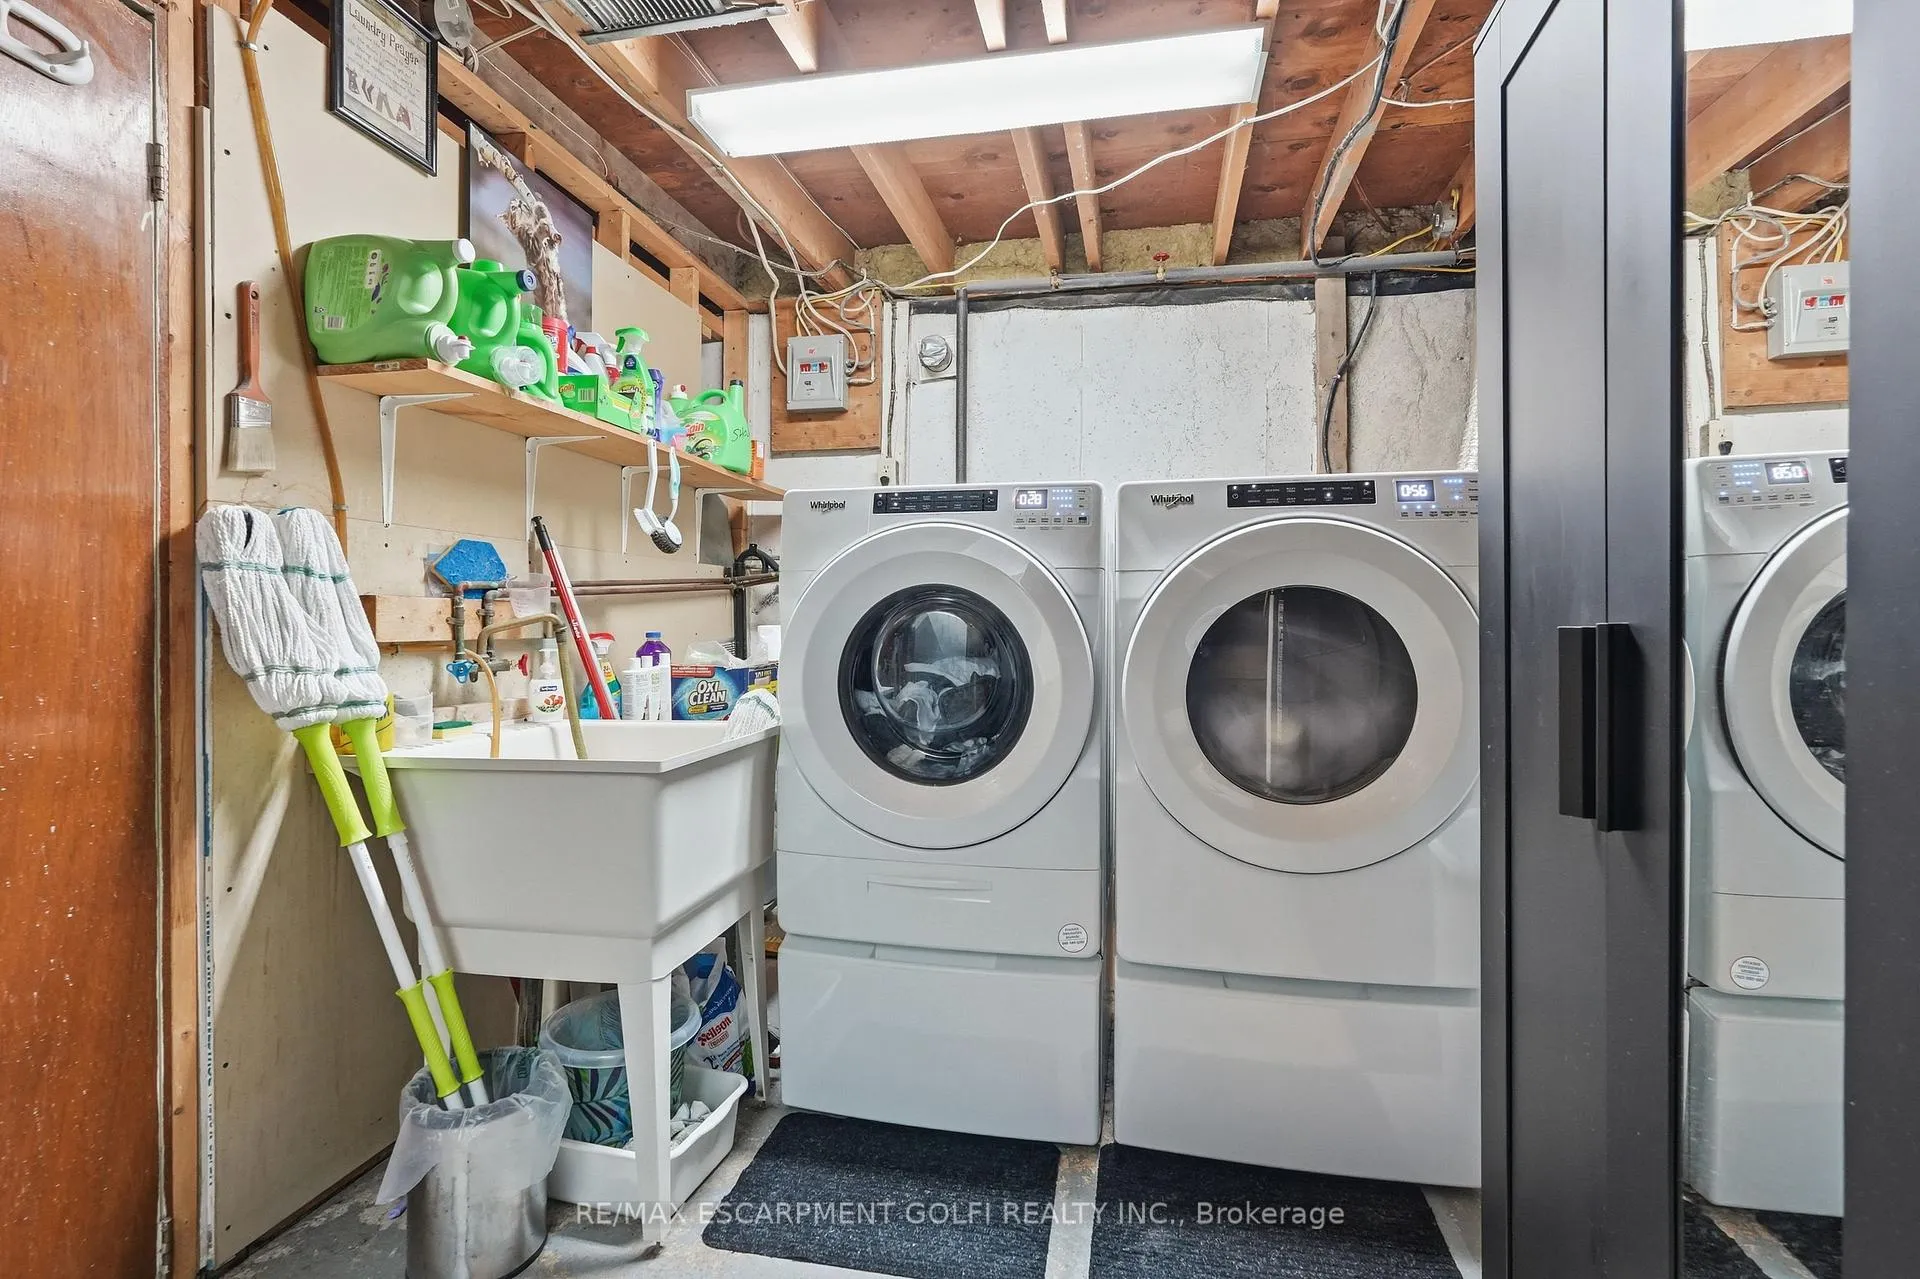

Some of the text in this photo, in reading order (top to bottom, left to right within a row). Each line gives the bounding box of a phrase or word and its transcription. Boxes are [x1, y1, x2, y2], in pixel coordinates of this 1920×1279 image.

[348, 2, 419, 65] Laundry Prayer
[810, 500, 846, 512] Whirlpool
[1150, 494, 1194, 508] Whirlpool
[697, 680, 719, 694] OXI
[689, 690, 727, 706] CLEAN
